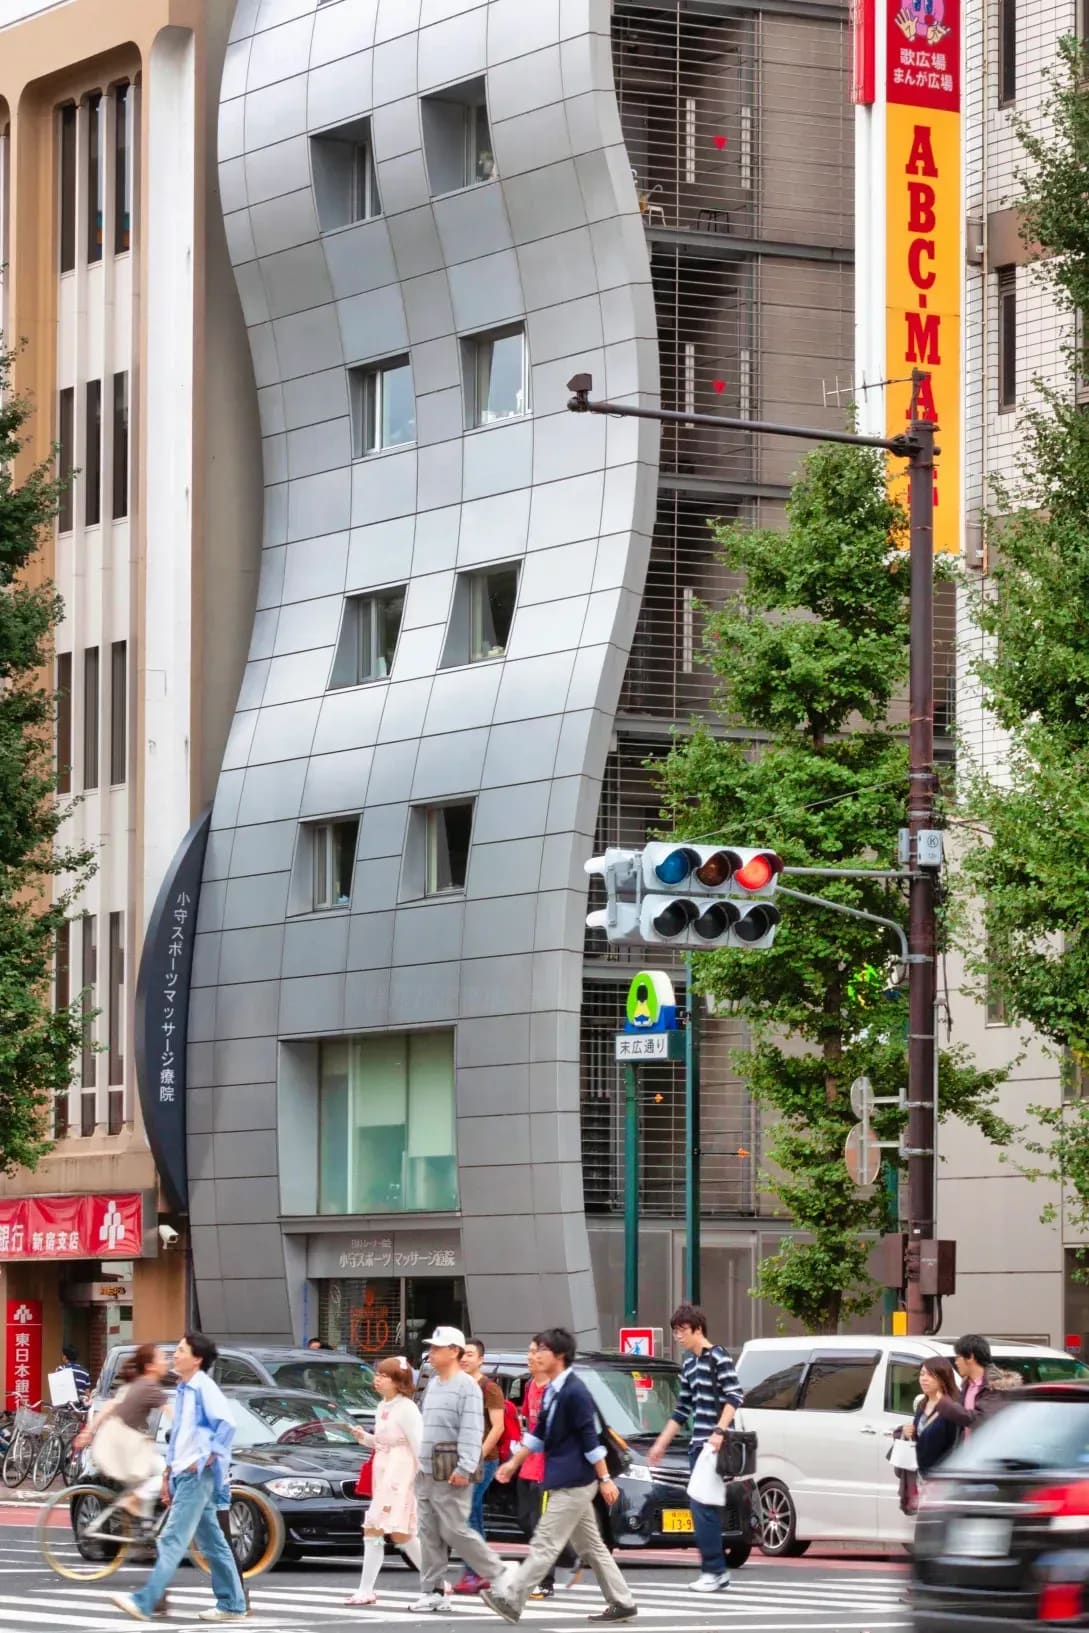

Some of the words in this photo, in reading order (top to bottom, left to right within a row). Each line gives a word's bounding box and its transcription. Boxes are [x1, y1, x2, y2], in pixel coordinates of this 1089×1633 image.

[900, 48, 946, 71] 歌広場
[893, 67, 953, 92] まんが広場
[905, 125, 941, 506] ABC-MA
[159, 891, 190, 1102] 小守スポーツマッサージ療院
[619, 1038, 665, 1056] 末広通り
[32, 1231, 79, 1251] 新宿支店
